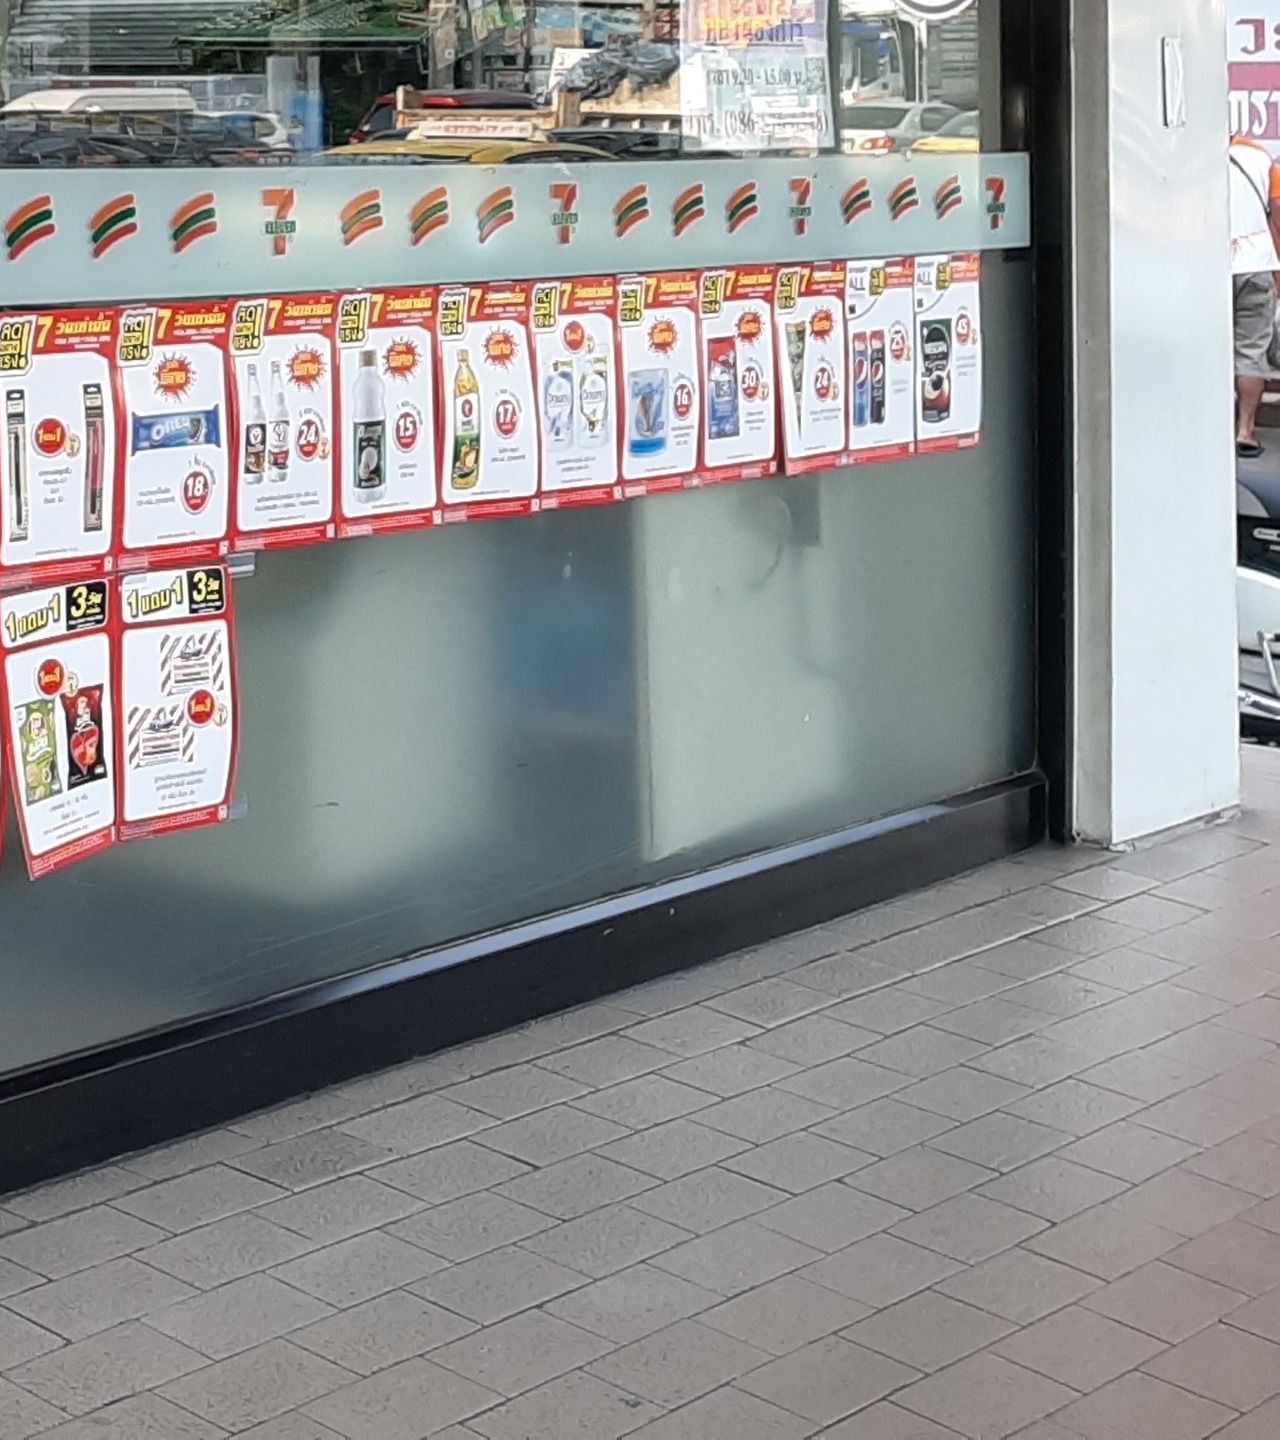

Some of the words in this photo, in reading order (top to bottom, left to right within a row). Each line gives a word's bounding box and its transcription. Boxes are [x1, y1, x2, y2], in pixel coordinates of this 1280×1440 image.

[550, 183, 578, 244] 7
[788, 177, 812, 235] 7
[986, 177, 1005, 229] 7
[263, 188, 294, 255] 7
[647, 278, 657, 303] 7
[725, 271, 736, 296] 7
[800, 268, 811, 292] 7
[371, 294, 385, 322] 7
[470, 289, 483, 316] 7
[561, 283, 572, 309] 7
[157, 309, 172, 339] 7
[268, 300, 282, 329] 7
[37, 315, 54, 348] 7
[127, 576, 183, 616] 1แถม1
[193, 572, 207, 601] 3
[5, 593, 61, 641] 1แถม1
[71, 586, 88, 616] 3
